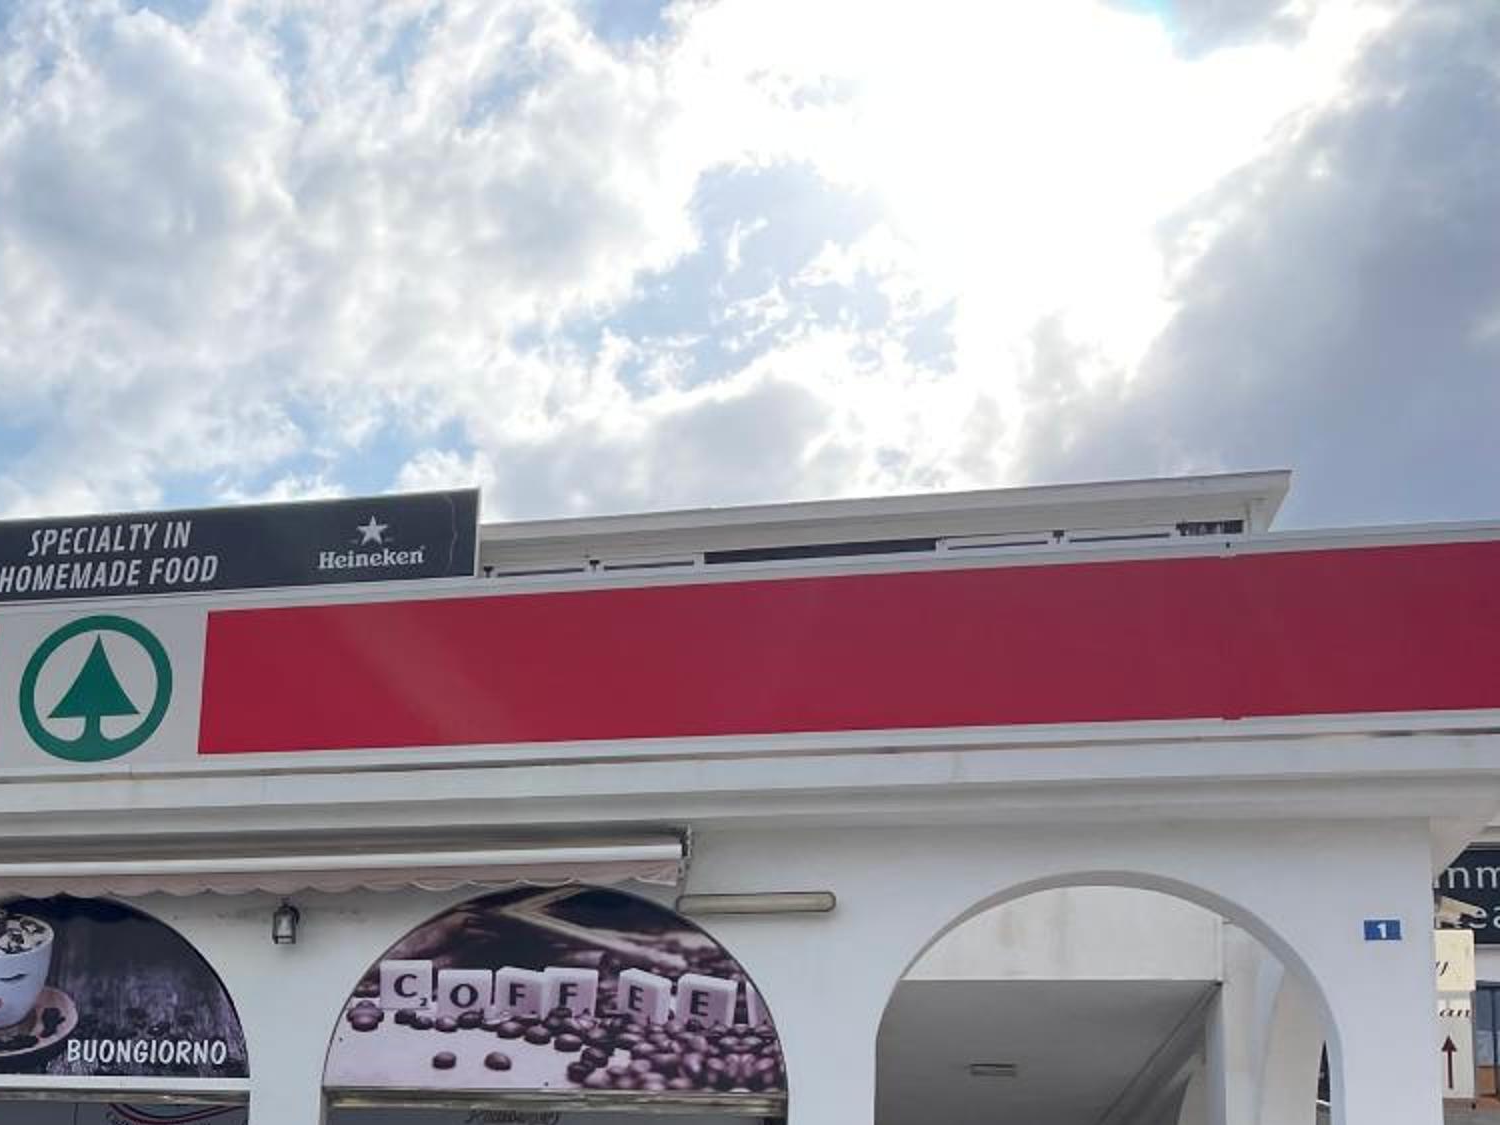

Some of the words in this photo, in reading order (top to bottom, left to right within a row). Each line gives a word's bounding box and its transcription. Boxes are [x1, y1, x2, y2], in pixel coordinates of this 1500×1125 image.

[28, 521, 158, 556] SPECIALTY
[163, 520, 191, 548] IN
[149, 555, 218, 585] FOOD
[318, 548, 425, 569] Heineken
[394, 974, 709, 1016] COFFEE
[67, 1039, 228, 1065] BUONGIORNO
